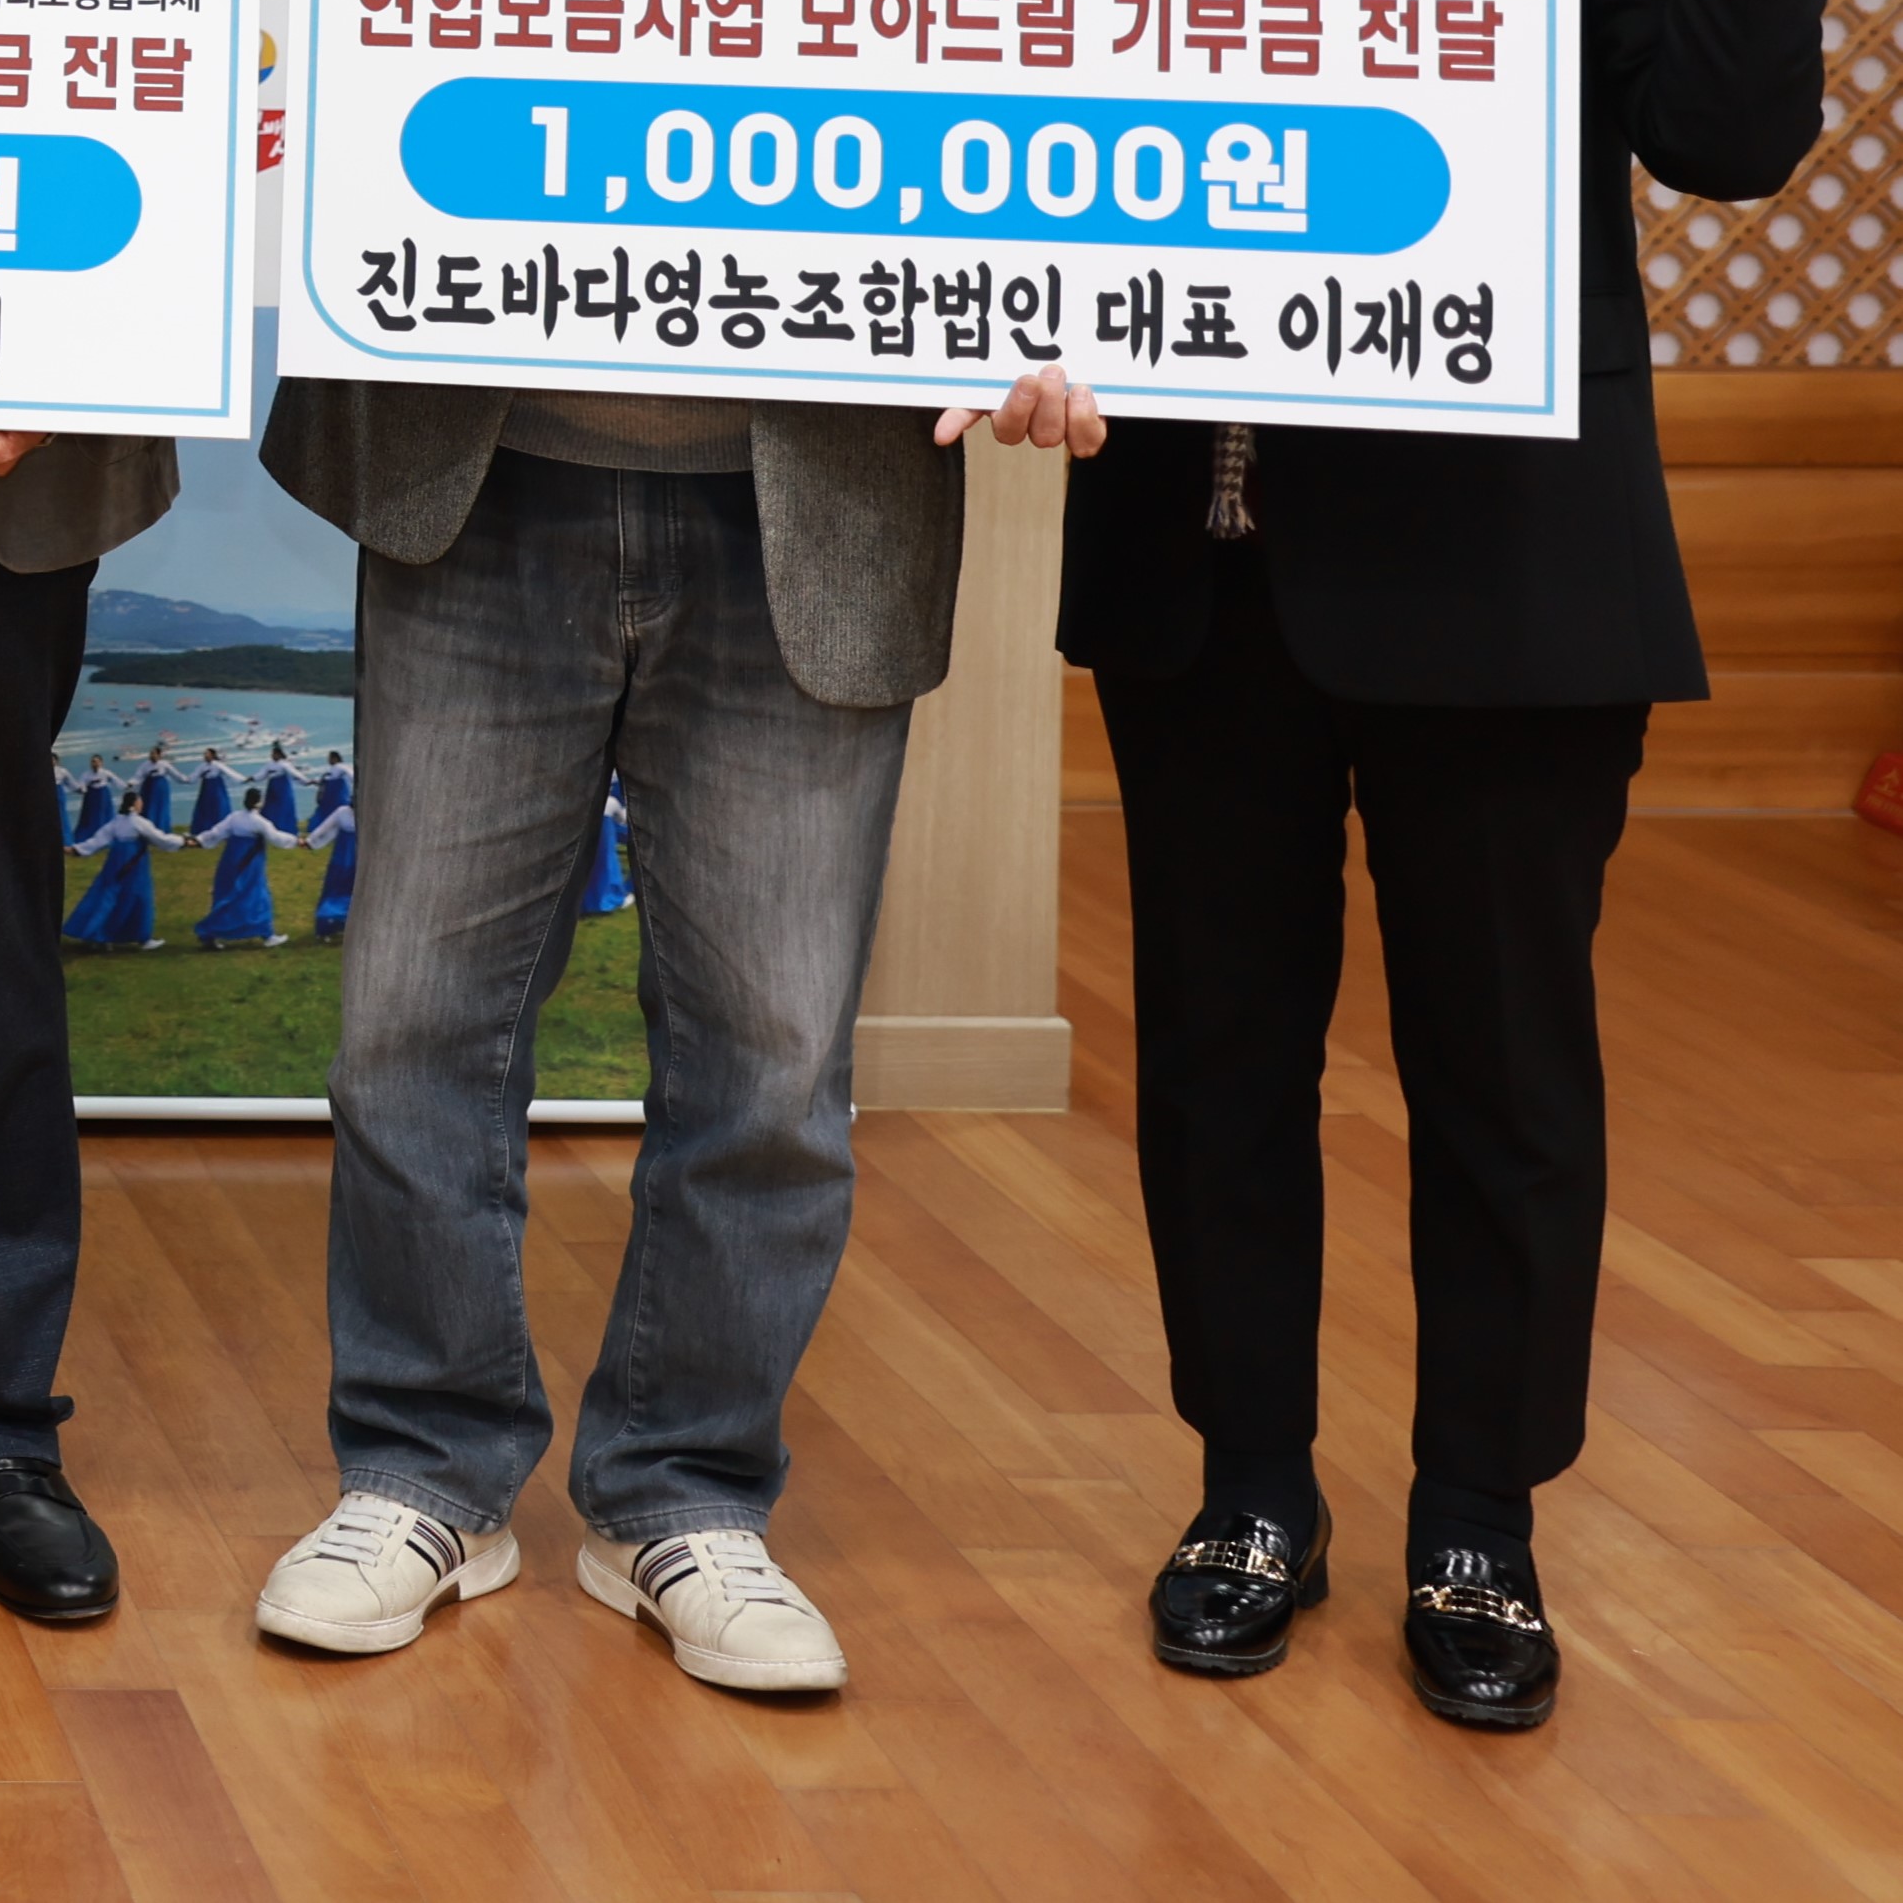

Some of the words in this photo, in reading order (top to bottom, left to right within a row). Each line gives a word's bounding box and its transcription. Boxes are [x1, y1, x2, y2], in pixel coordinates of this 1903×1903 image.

[64, 36, 191, 111] 전달
[532, 107, 1307, 232] 1,000,000원
[357, 238, 1062, 361] 진도바다영농조합법인
[1096, 270, 1248, 367] 대표
[1279, 276, 1493, 384] 이재영
